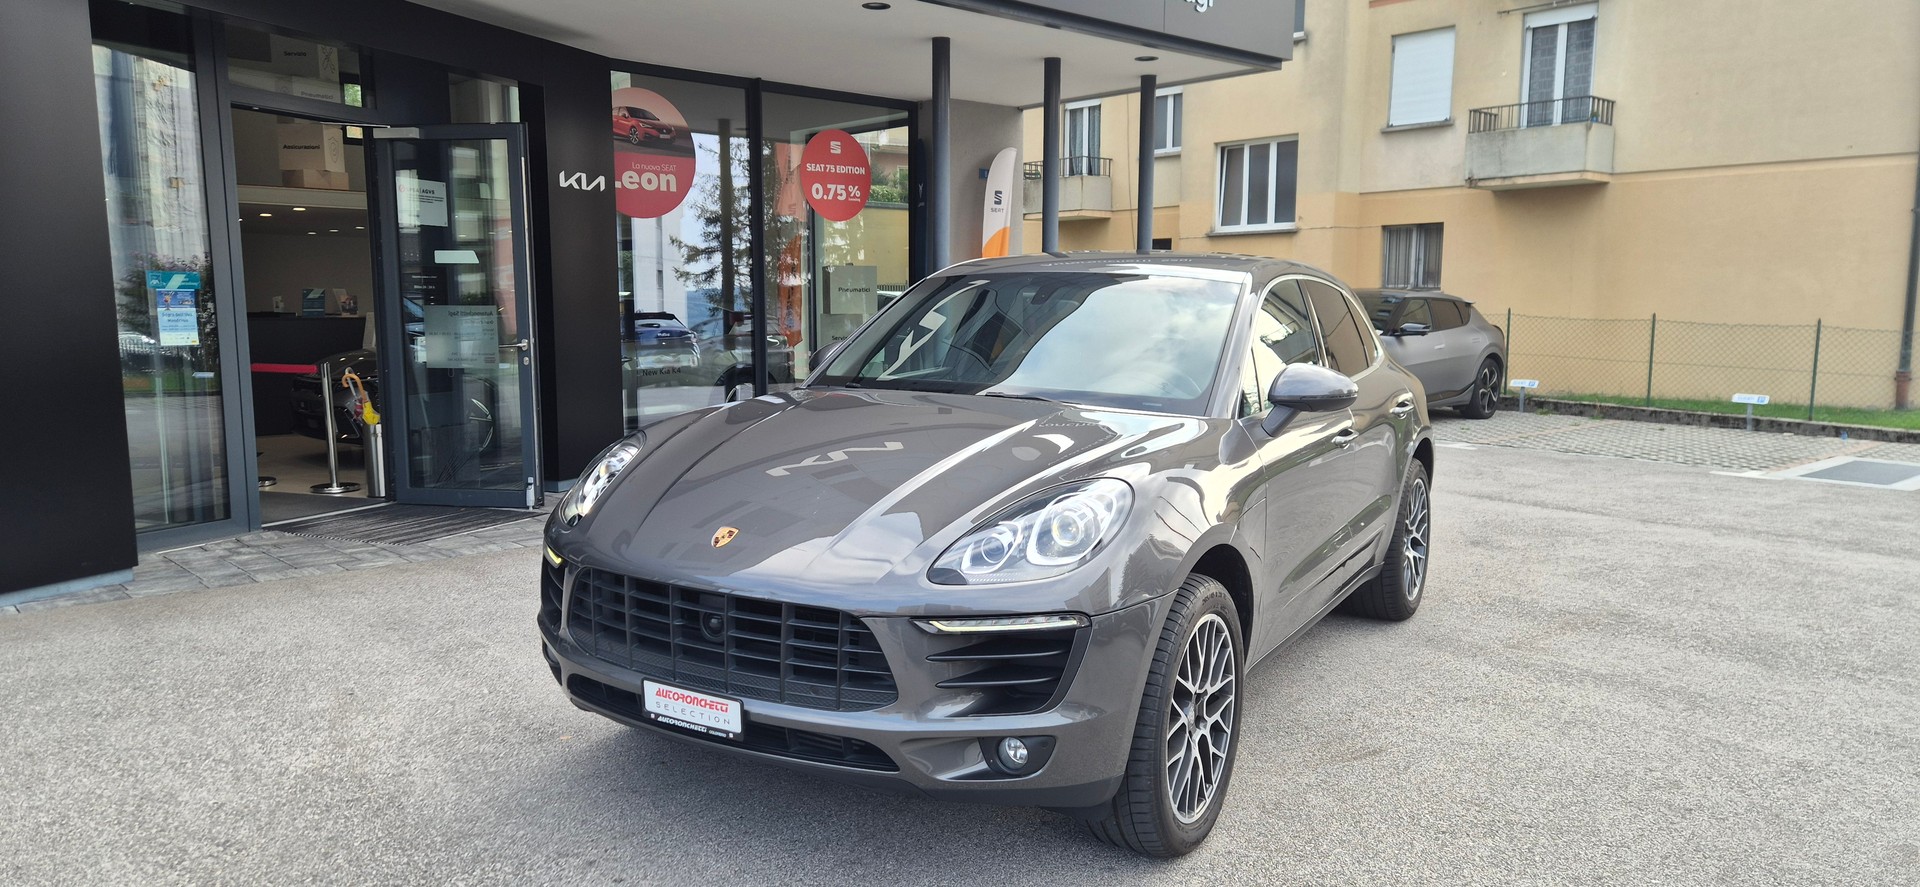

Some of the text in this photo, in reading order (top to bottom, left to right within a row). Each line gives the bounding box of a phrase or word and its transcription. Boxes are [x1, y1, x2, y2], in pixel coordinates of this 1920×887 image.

[631, 161, 677, 172] La nuova SEAT
[806, 163, 866, 175] SEAT 75 EDITION
[559, 170, 606, 192] KIA
[614, 170, 677, 193] eon
[811, 183, 847, 201] 0.75
[642, 369, 658, 377] New
[655, 687, 729, 713] AUTORONCHETTI
[655, 701, 731, 725] SELECTION
[657, 715, 708, 733] AUTORONCHETTI
